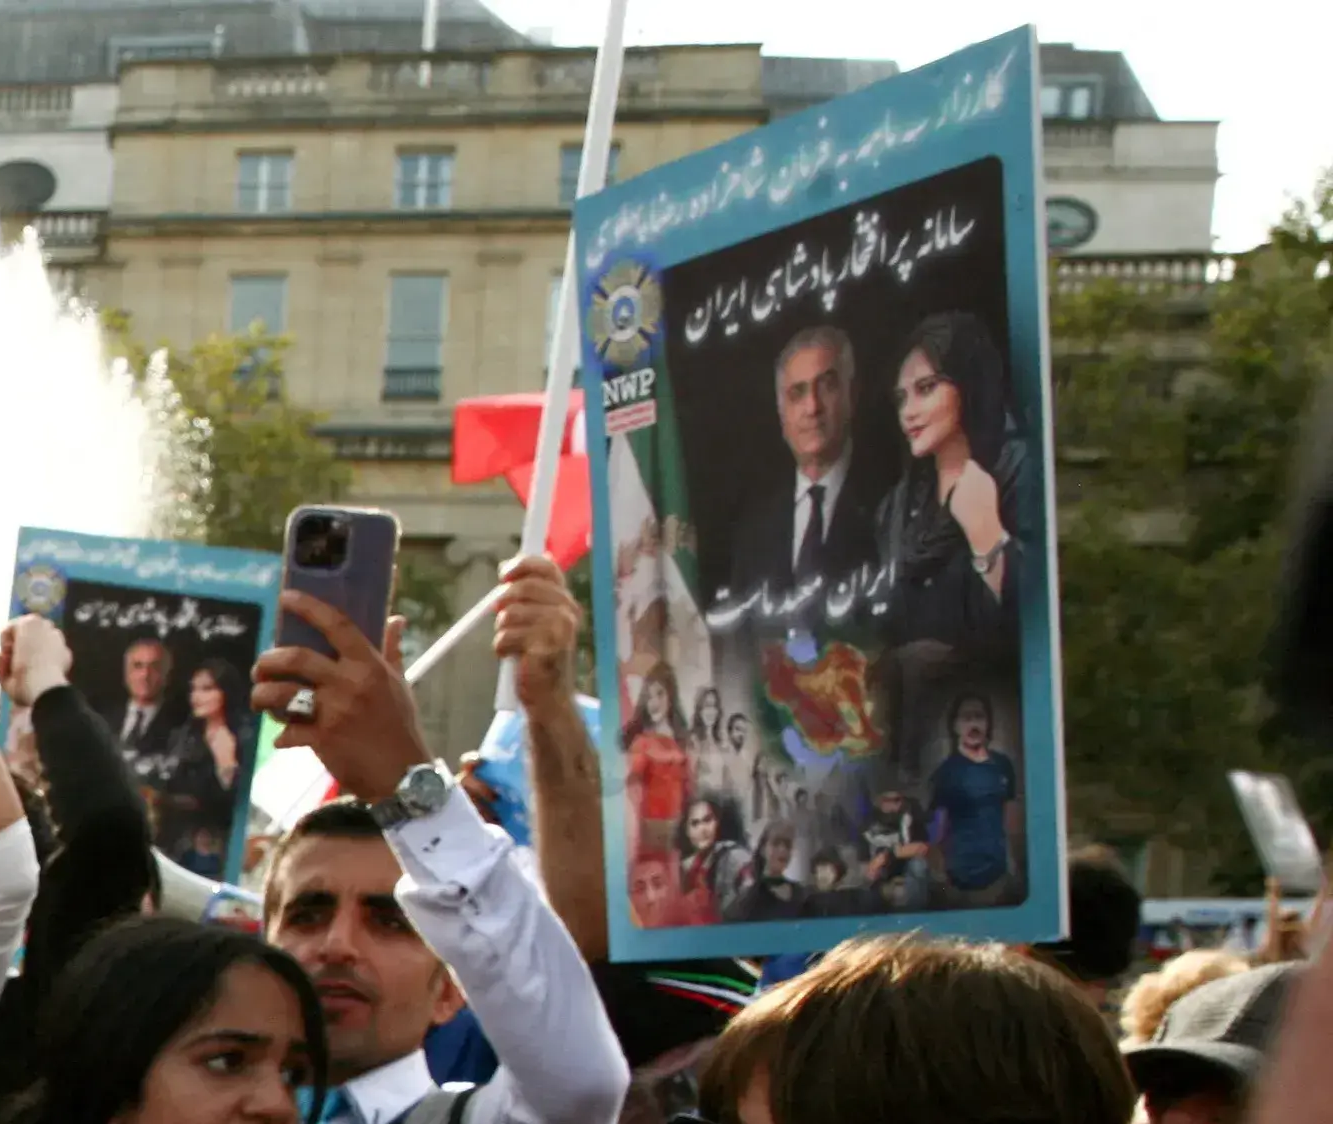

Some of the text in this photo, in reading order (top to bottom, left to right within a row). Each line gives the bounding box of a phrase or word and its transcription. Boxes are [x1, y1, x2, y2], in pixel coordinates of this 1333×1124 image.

[688, 144, 767, 222] شاهزاده
[767, 113, 832, 206] فرمان
[836, 209, 888, 285] افتخار
[915, 204, 976, 260] سامانه
[684, 276, 747, 344] ایران
[749, 241, 838, 323] پادشاهی
[602, 367, 656, 408] NWP
[704, 578, 775, 627] ماست
[825, 557, 897, 621] ایران
